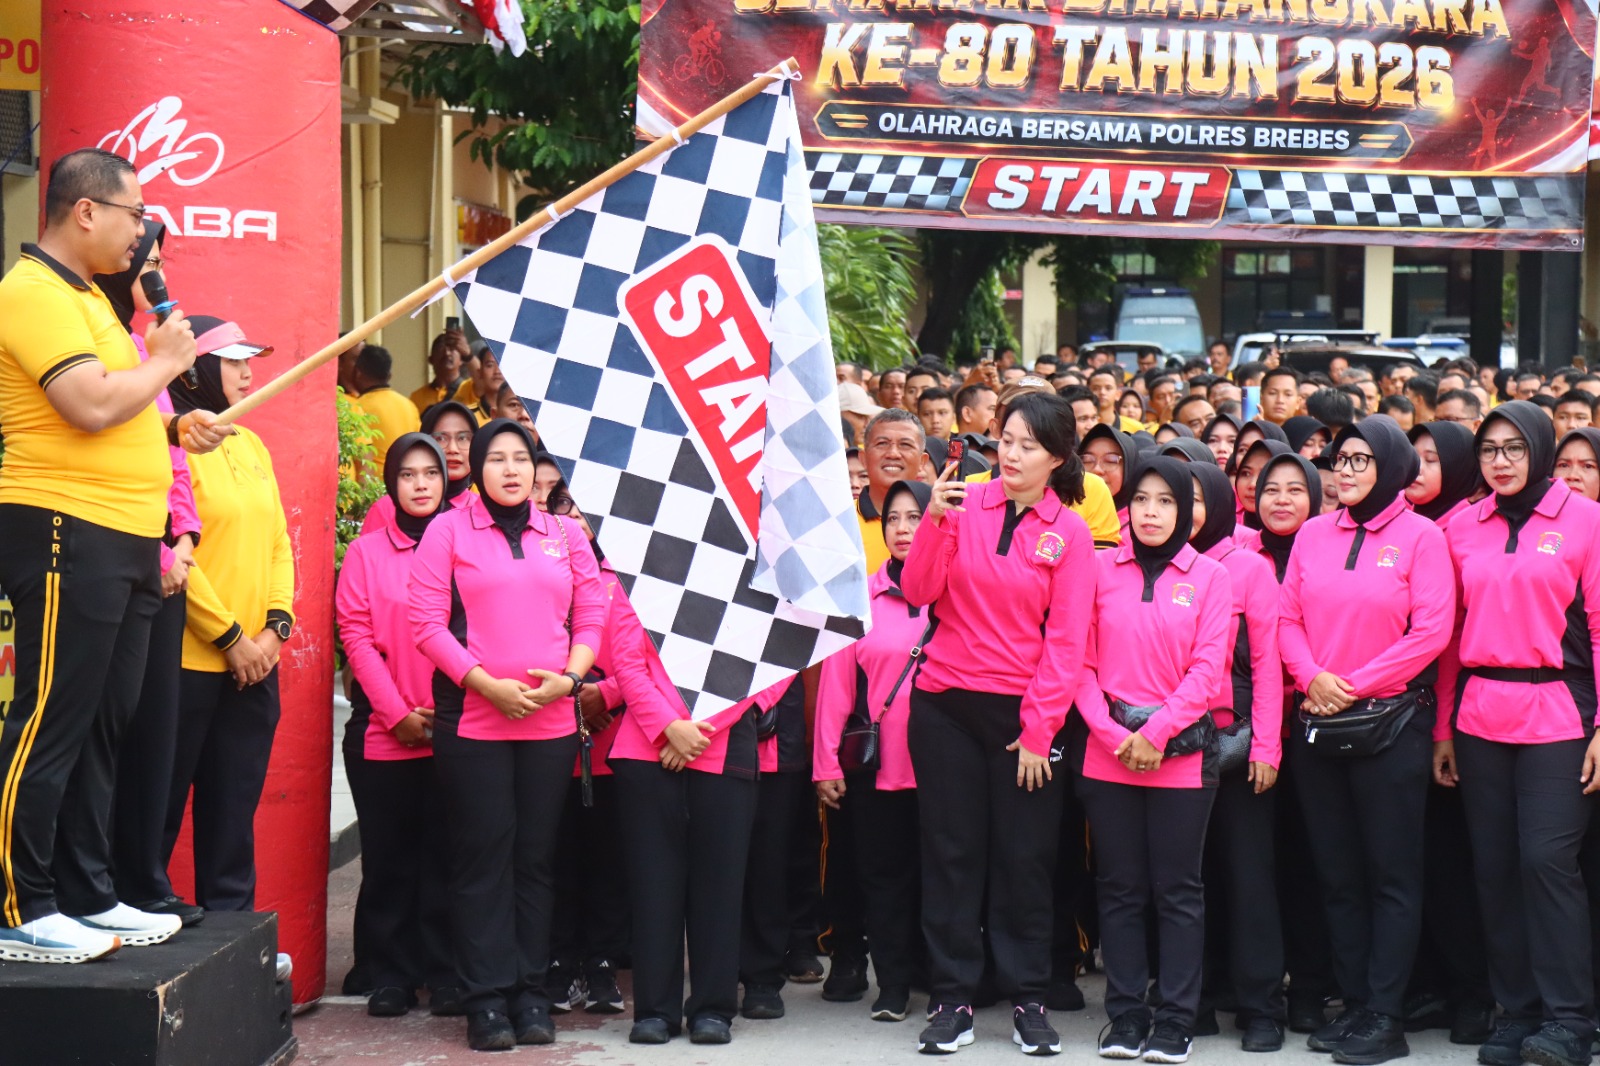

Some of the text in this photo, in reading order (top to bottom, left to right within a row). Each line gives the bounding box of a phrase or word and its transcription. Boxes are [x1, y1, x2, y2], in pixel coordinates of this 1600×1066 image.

[814, 22, 1455, 112] KE-80 TAHUN 2026
[878, 112, 1350, 150] OLAHRAGA BERSAMA POLRES BREBES
[987, 164, 1211, 217] START
[52, 510, 63, 567] OLRI
